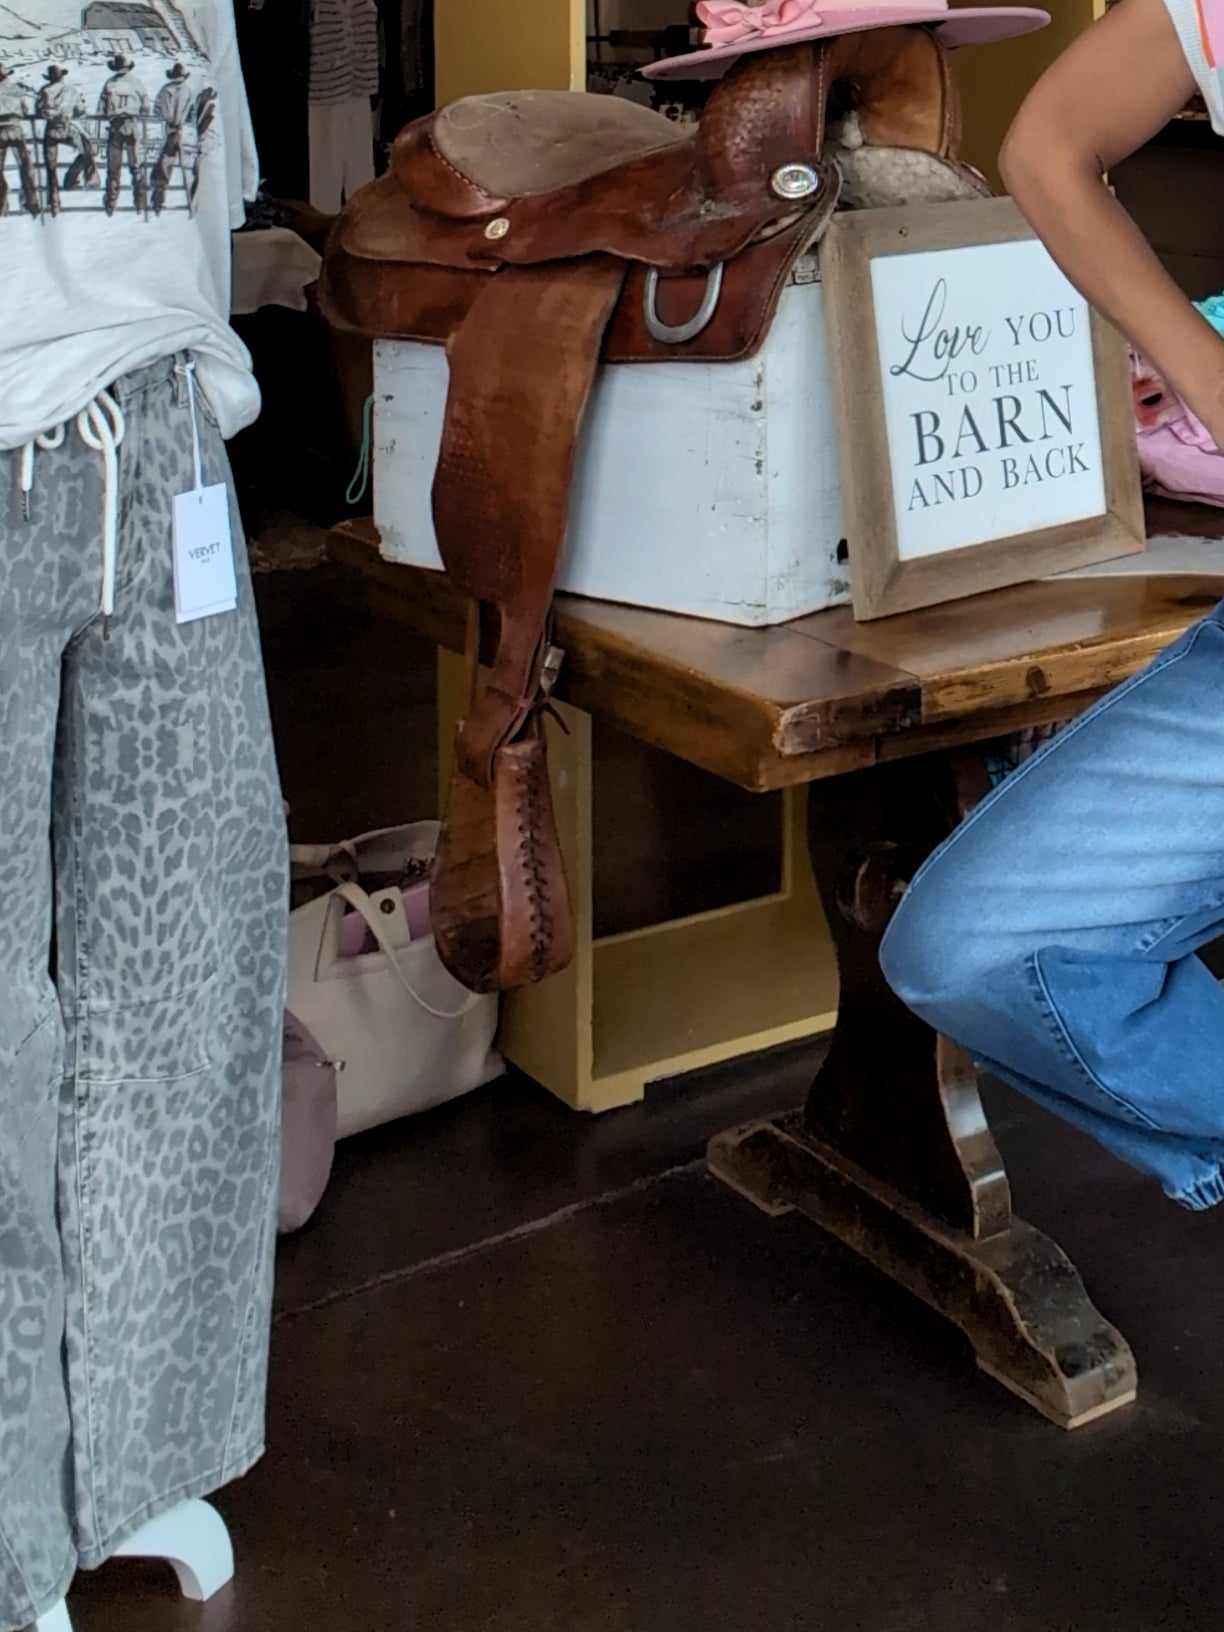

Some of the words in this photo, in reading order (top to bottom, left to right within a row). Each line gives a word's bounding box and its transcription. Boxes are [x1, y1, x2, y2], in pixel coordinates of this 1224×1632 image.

[889, 277, 990, 382] Love
[1004, 307, 1076, 347] YOU
[944, 370, 978, 397] TO
[988, 359, 1040, 388] THE
[909, 383, 1075, 467] BARN
[906, 465, 984, 512] AND
[1000, 442, 1091, 491] BACK
